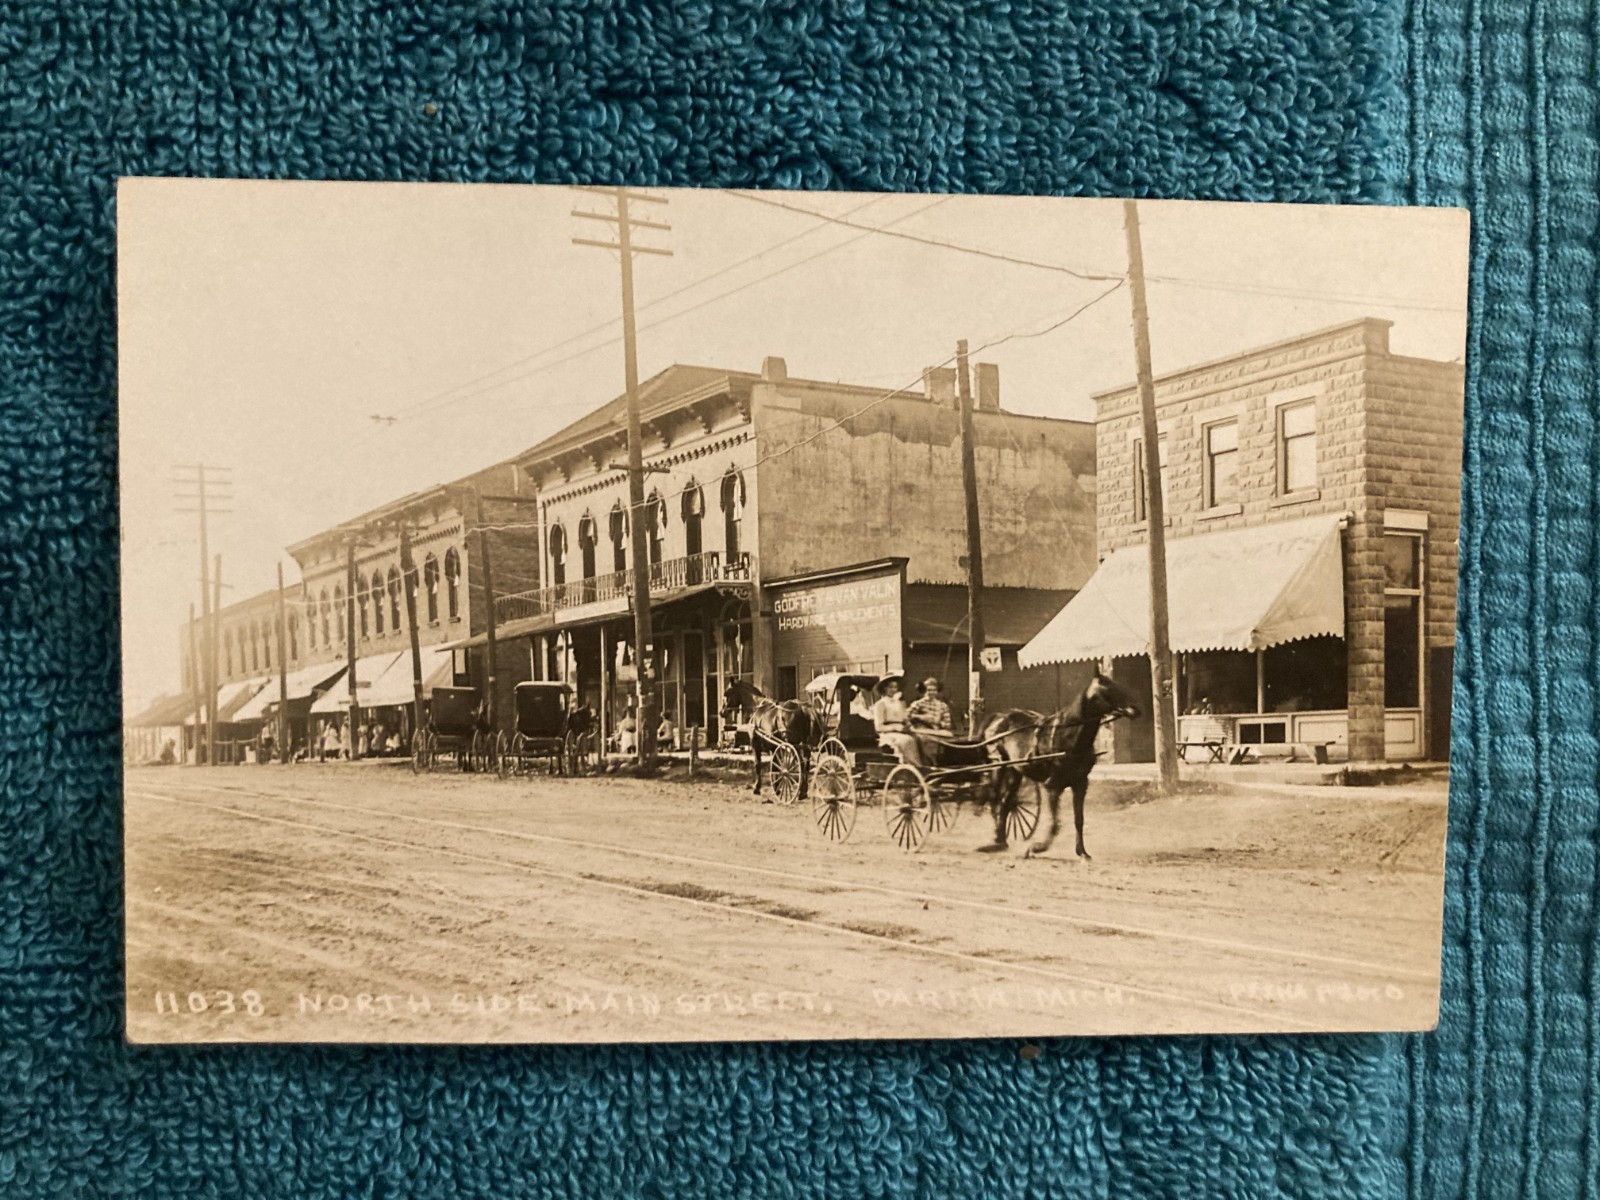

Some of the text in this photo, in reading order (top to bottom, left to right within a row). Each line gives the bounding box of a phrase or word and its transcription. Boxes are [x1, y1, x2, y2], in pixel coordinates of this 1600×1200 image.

[154, 989, 265, 1017] 11038
[299, 992, 432, 1014] NORTH
[448, 992, 542, 1015] SIDE
[566, 991, 661, 1016] MAIN
